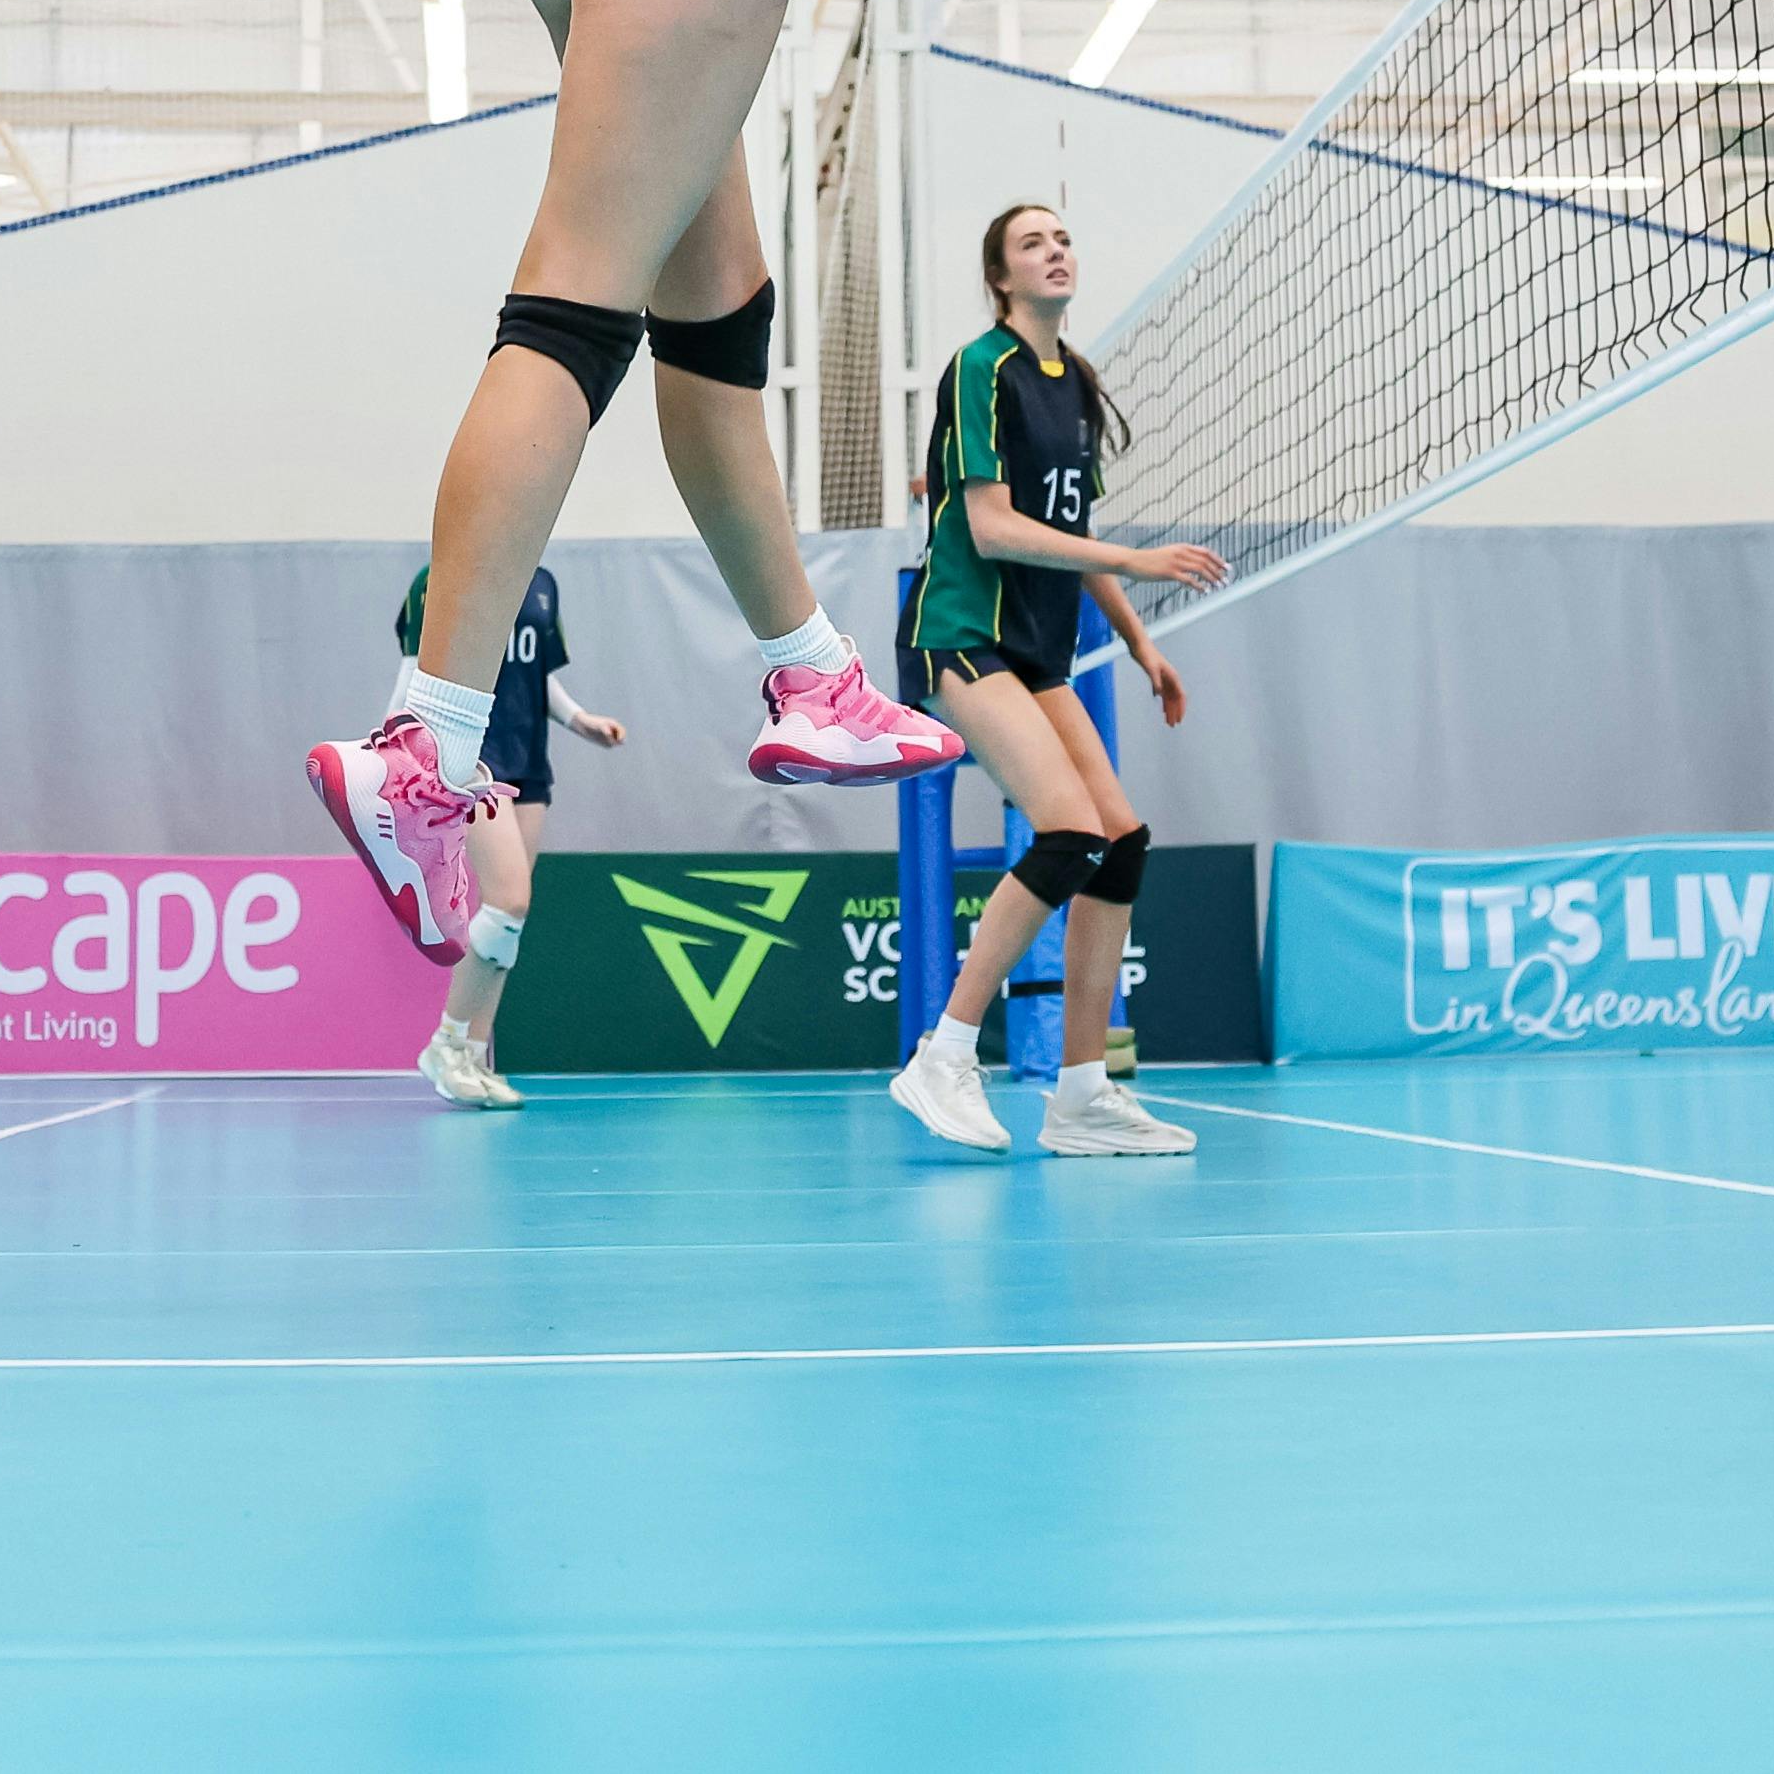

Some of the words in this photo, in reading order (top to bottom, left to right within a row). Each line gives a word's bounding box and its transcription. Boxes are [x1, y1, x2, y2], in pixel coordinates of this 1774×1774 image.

[1043, 467, 1082, 522] 15
[507, 625, 537, 663] 10
[1441, 880, 1603, 970] IT'S
[25, 1010, 118, 1048] Living
[1442, 996, 1494, 1033] in
